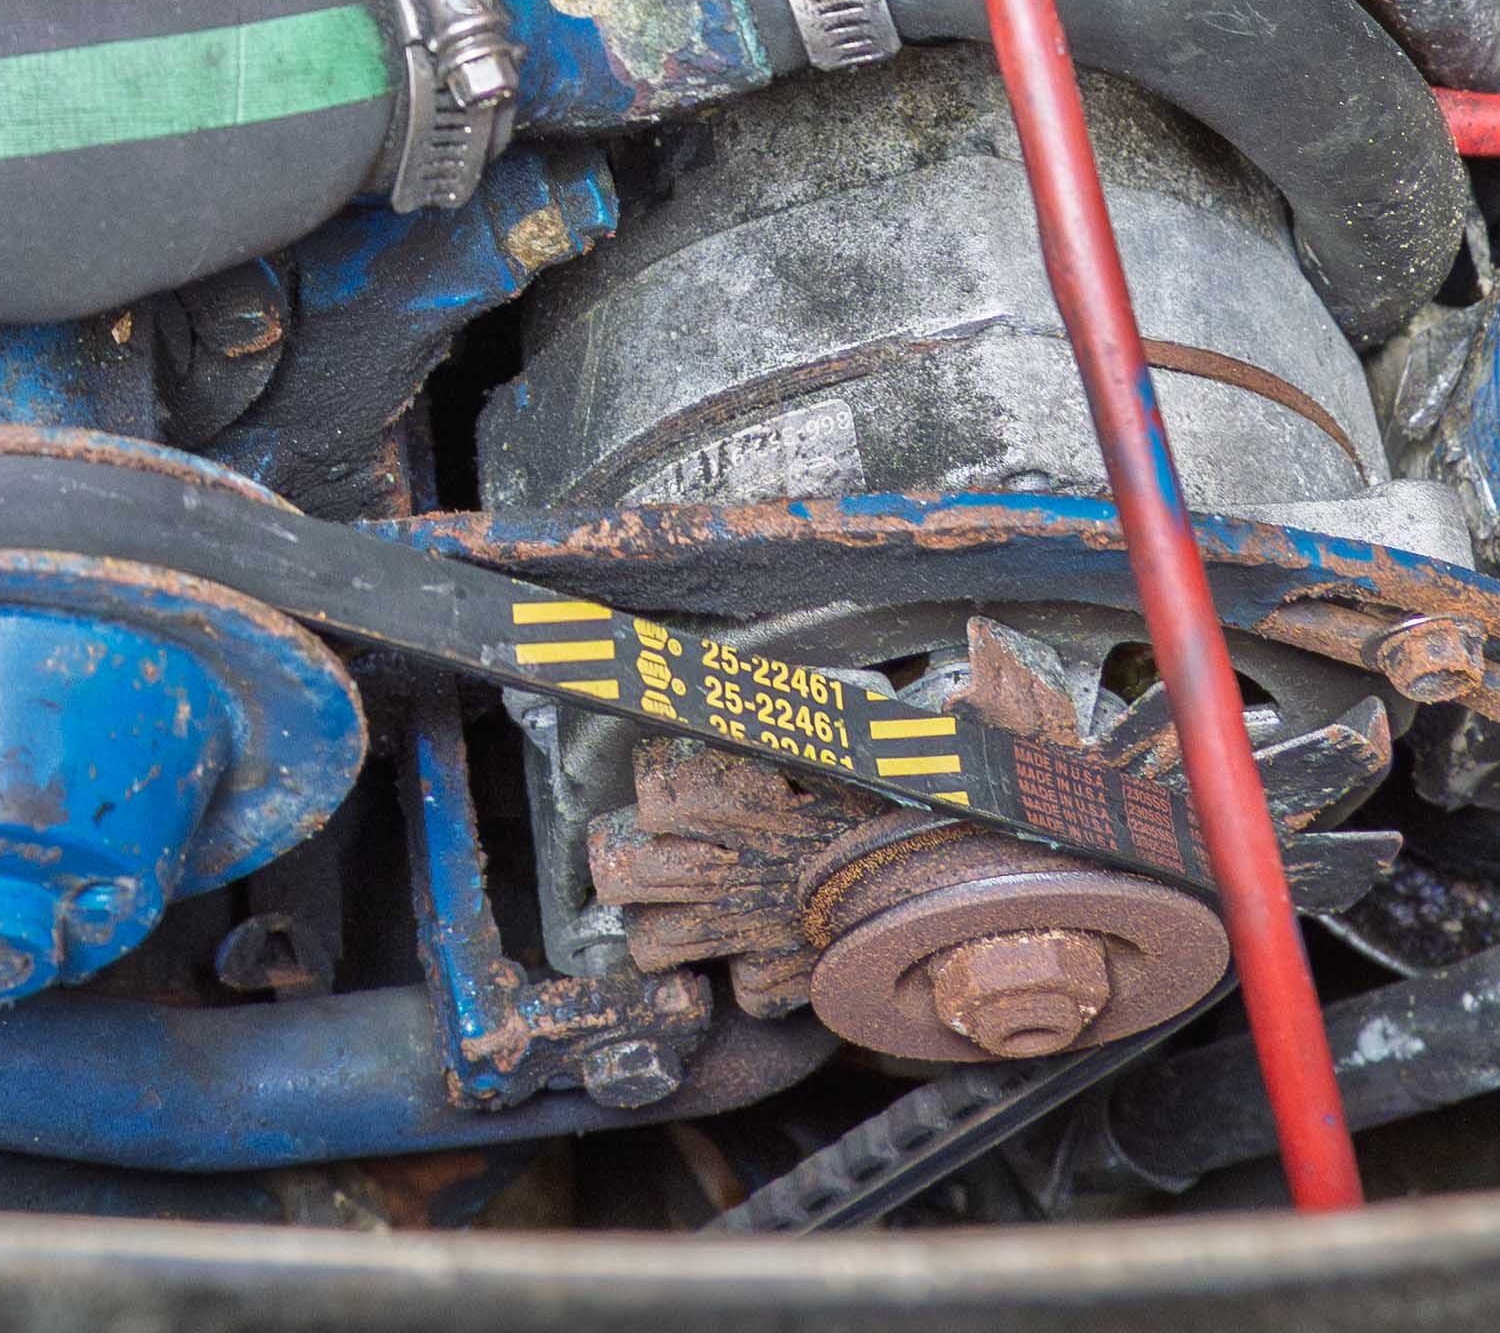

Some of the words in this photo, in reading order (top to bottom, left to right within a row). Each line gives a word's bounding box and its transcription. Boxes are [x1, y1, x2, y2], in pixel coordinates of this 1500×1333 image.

[701, 638, 844, 710] 25-22461
[704, 675, 849, 748] 25-22461
[1014, 746, 1053, 772] MADE
[1056, 758, 1069, 776] IN
[1016, 763, 1055, 788] MADE
[1057, 776, 1071, 793] IN
[1018, 779, 1058, 803] MADE
[1060, 793, 1074, 809] IN
[1022, 796, 1061, 820] MADE
